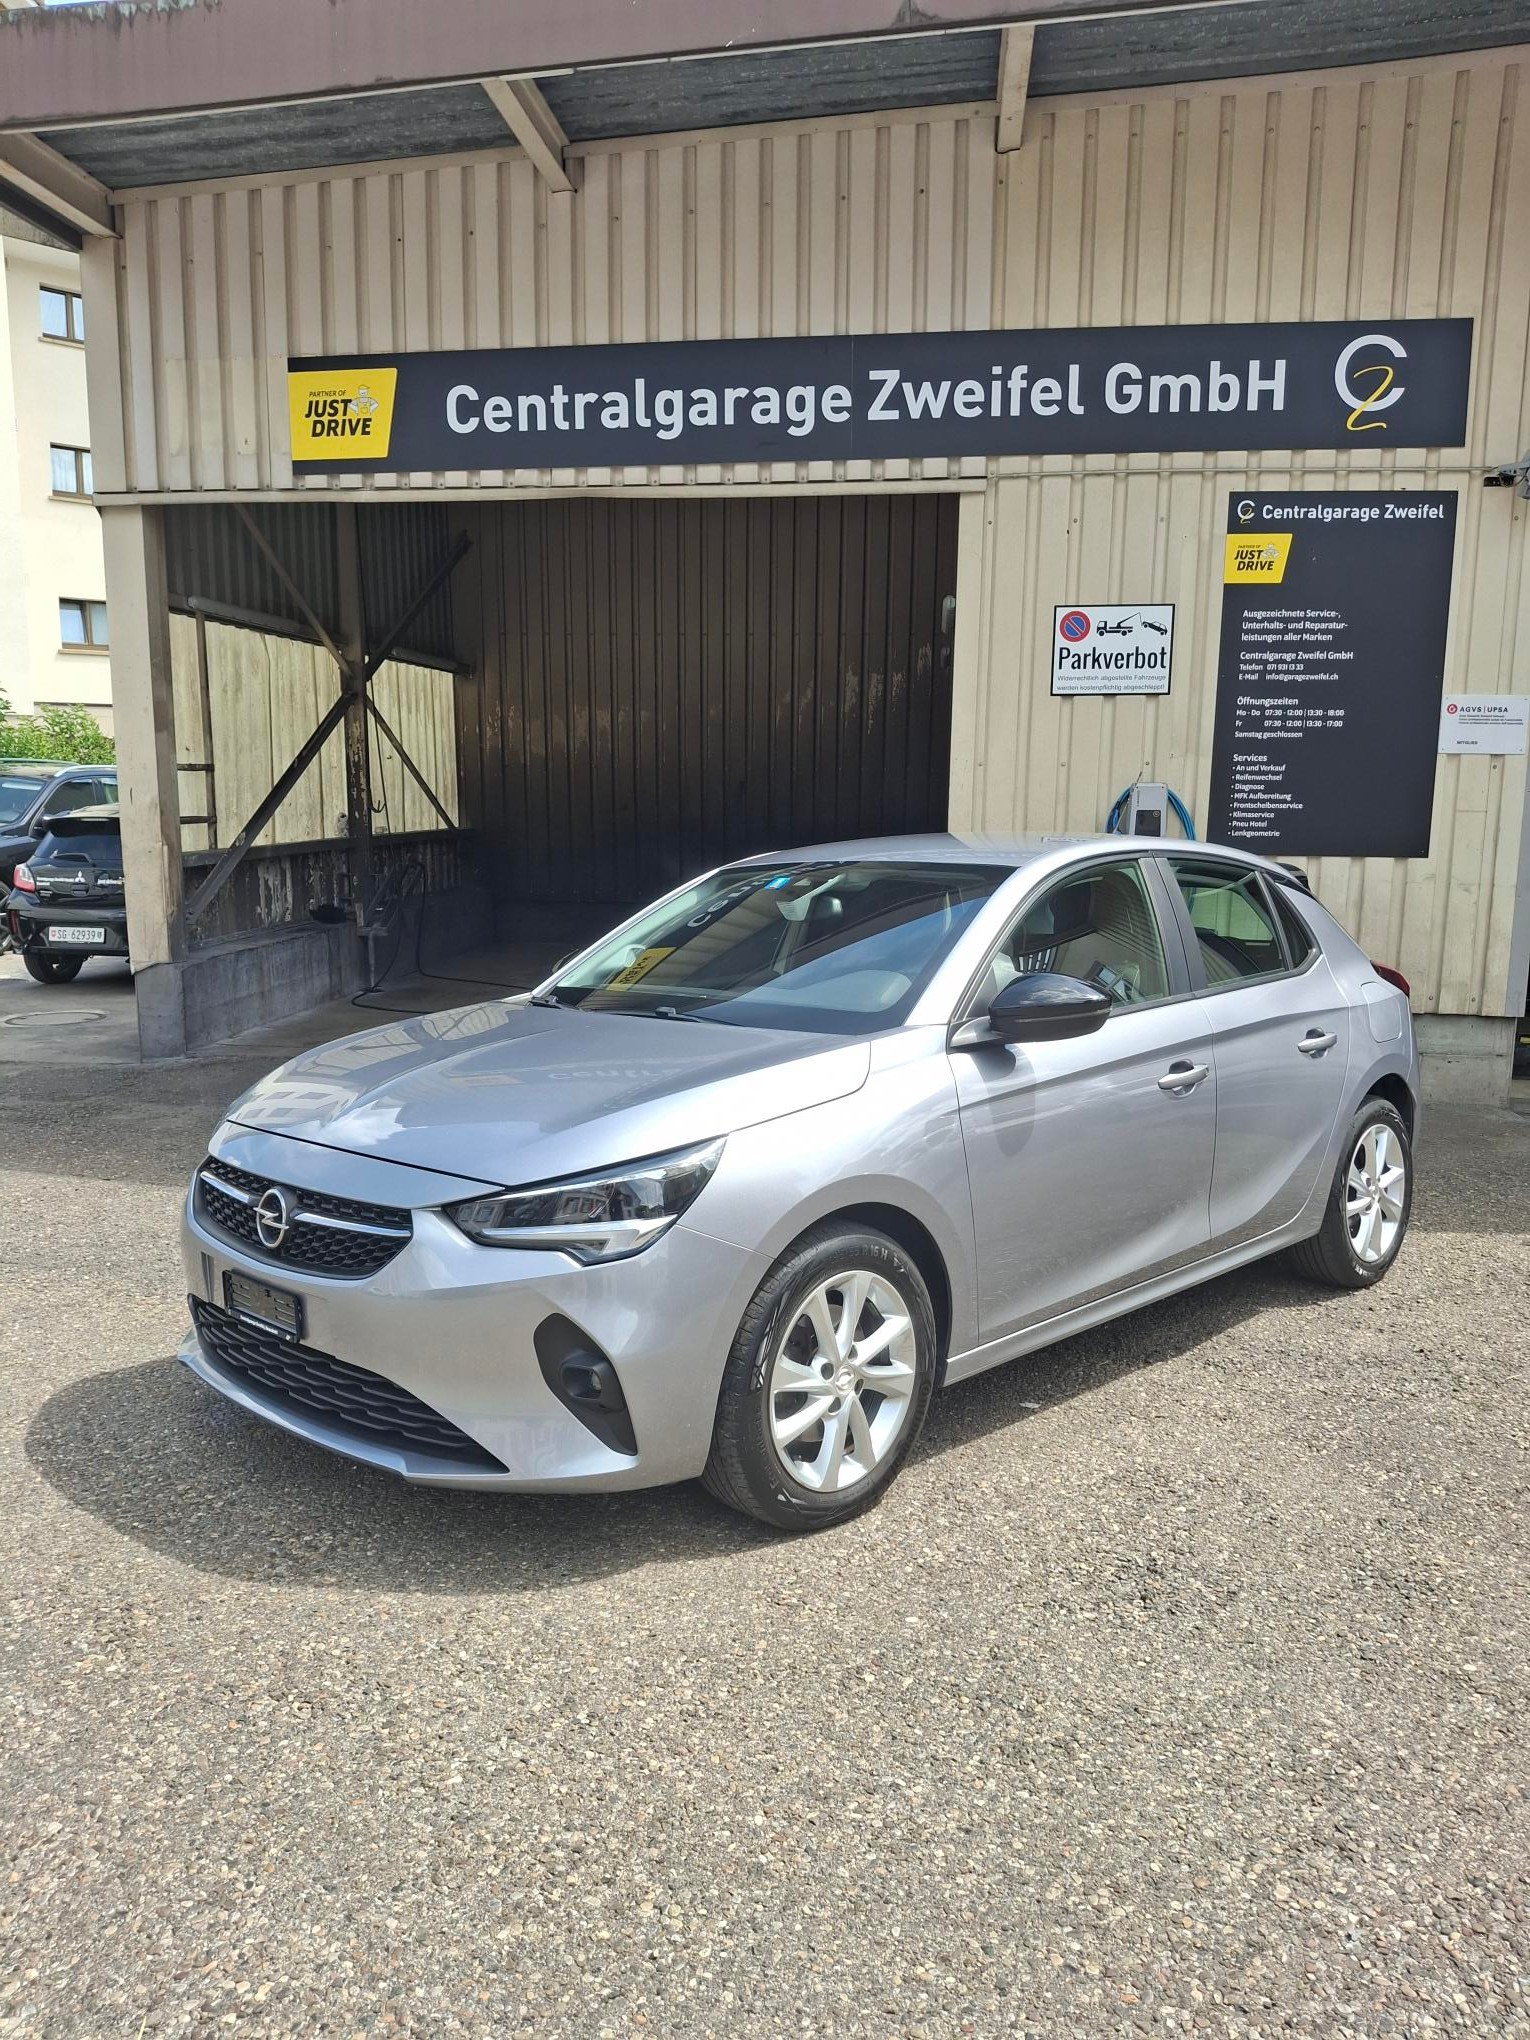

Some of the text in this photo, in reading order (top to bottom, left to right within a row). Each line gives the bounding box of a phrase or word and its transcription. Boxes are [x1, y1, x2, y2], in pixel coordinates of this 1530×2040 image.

[446, 359, 1287, 440] Centralgarage Zweifel GmbH
[305, 399, 352, 418] JUST
[311, 418, 372, 437] DRIVE
[1262, 504, 1444, 522] Centralgarage Zweifel
[1234, 550, 1264, 560] JUST
[1237, 561, 1274, 571] DRIVE
[1242, 609, 1305, 619] Ausgezeichnete
[1242, 621, 1349, 631] Unterhalts- und Reparatur-
[1241, 633, 1332, 642] leistungen aller Marken
[1058, 646, 1167, 670] Parkverbot
[1240, 651, 1354, 661] Centralgarage Zweifel GmbH
[1239, 663, 1263, 671] Telefon
[1265, 673, 1339, 681] info@garagezweifel.ch
[1237, 696, 1299, 707] Öffnungszeiten
[1234, 731, 1303, 739] Samstag geschlossen
[1233, 753, 1267, 761] Services
[1234, 783, 1265, 791] Diagnose
[1249, 792, 1292, 801] Aufbereitung
[1231, 829, 1280, 838] Lenkgeometrie
[57, 929, 96, 940] SG 62939
